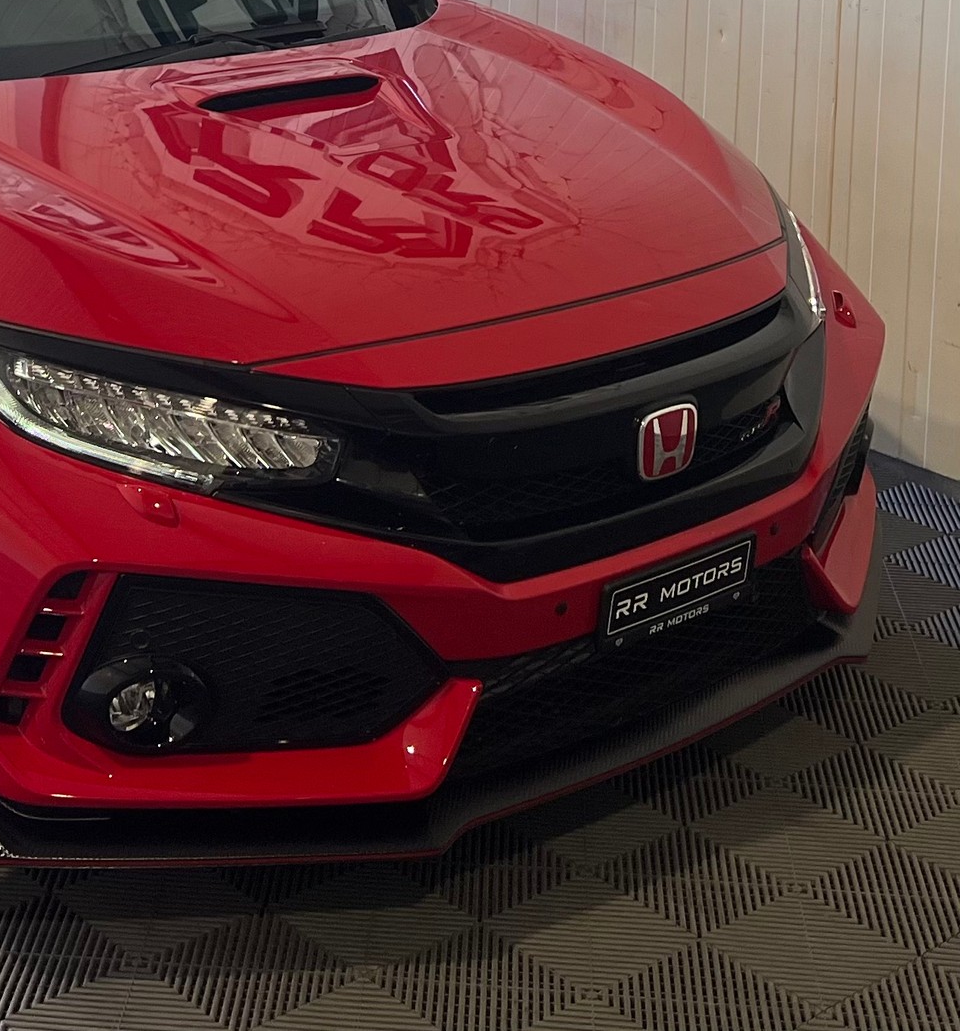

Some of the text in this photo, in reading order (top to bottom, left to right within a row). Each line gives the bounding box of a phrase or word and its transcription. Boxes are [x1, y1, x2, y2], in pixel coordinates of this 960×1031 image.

[615, 557, 743, 619] RR MOTORS
[649, 604, 710, 635] RR MOTORS
